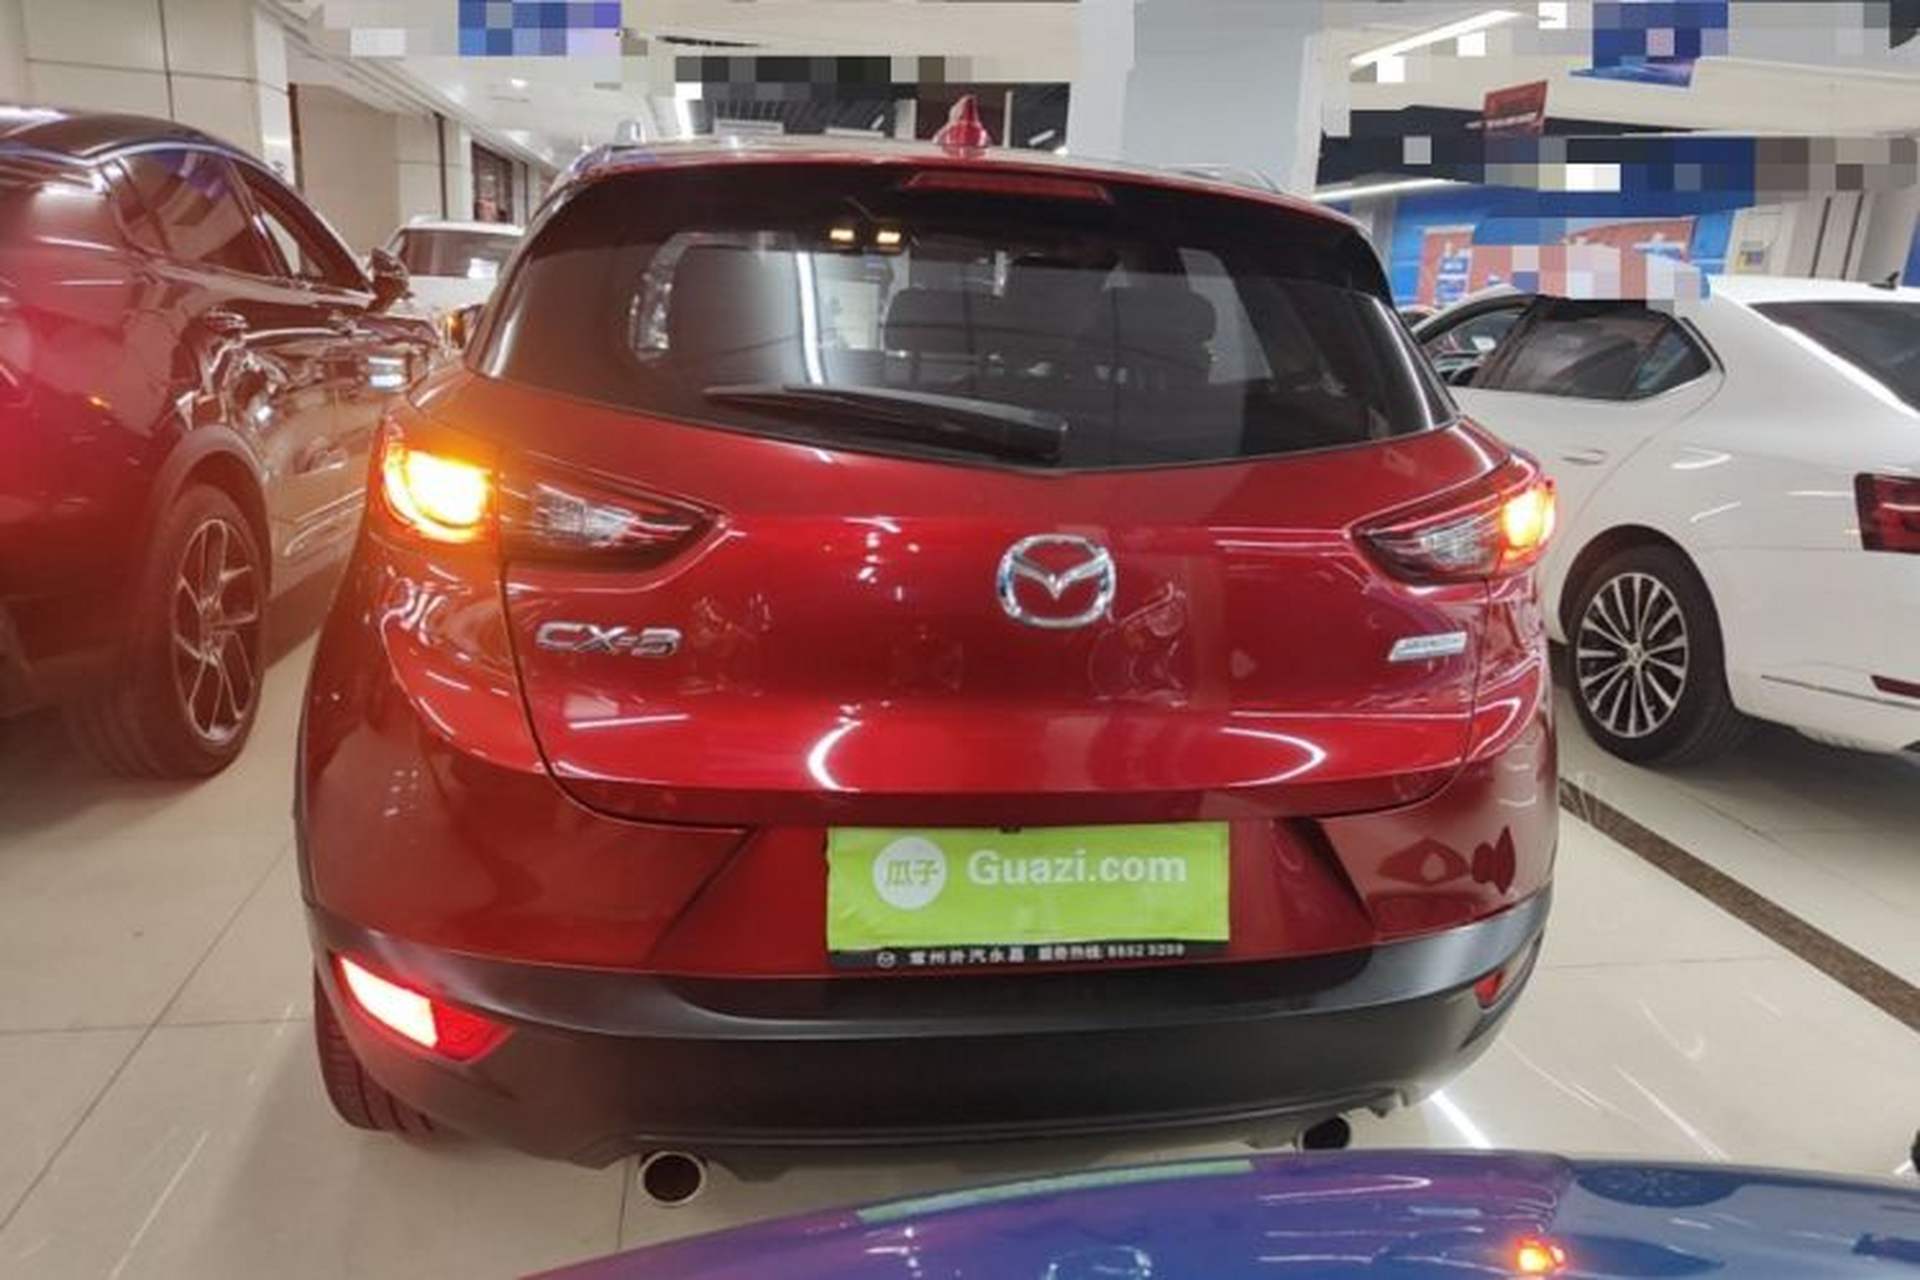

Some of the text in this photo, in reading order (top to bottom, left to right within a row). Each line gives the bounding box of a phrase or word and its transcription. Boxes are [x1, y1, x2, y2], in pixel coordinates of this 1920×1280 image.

[535, 620, 683, 657] CX-3
[885, 858, 940, 887] 瓜子
[967, 849, 1188, 886] Guazi.com
